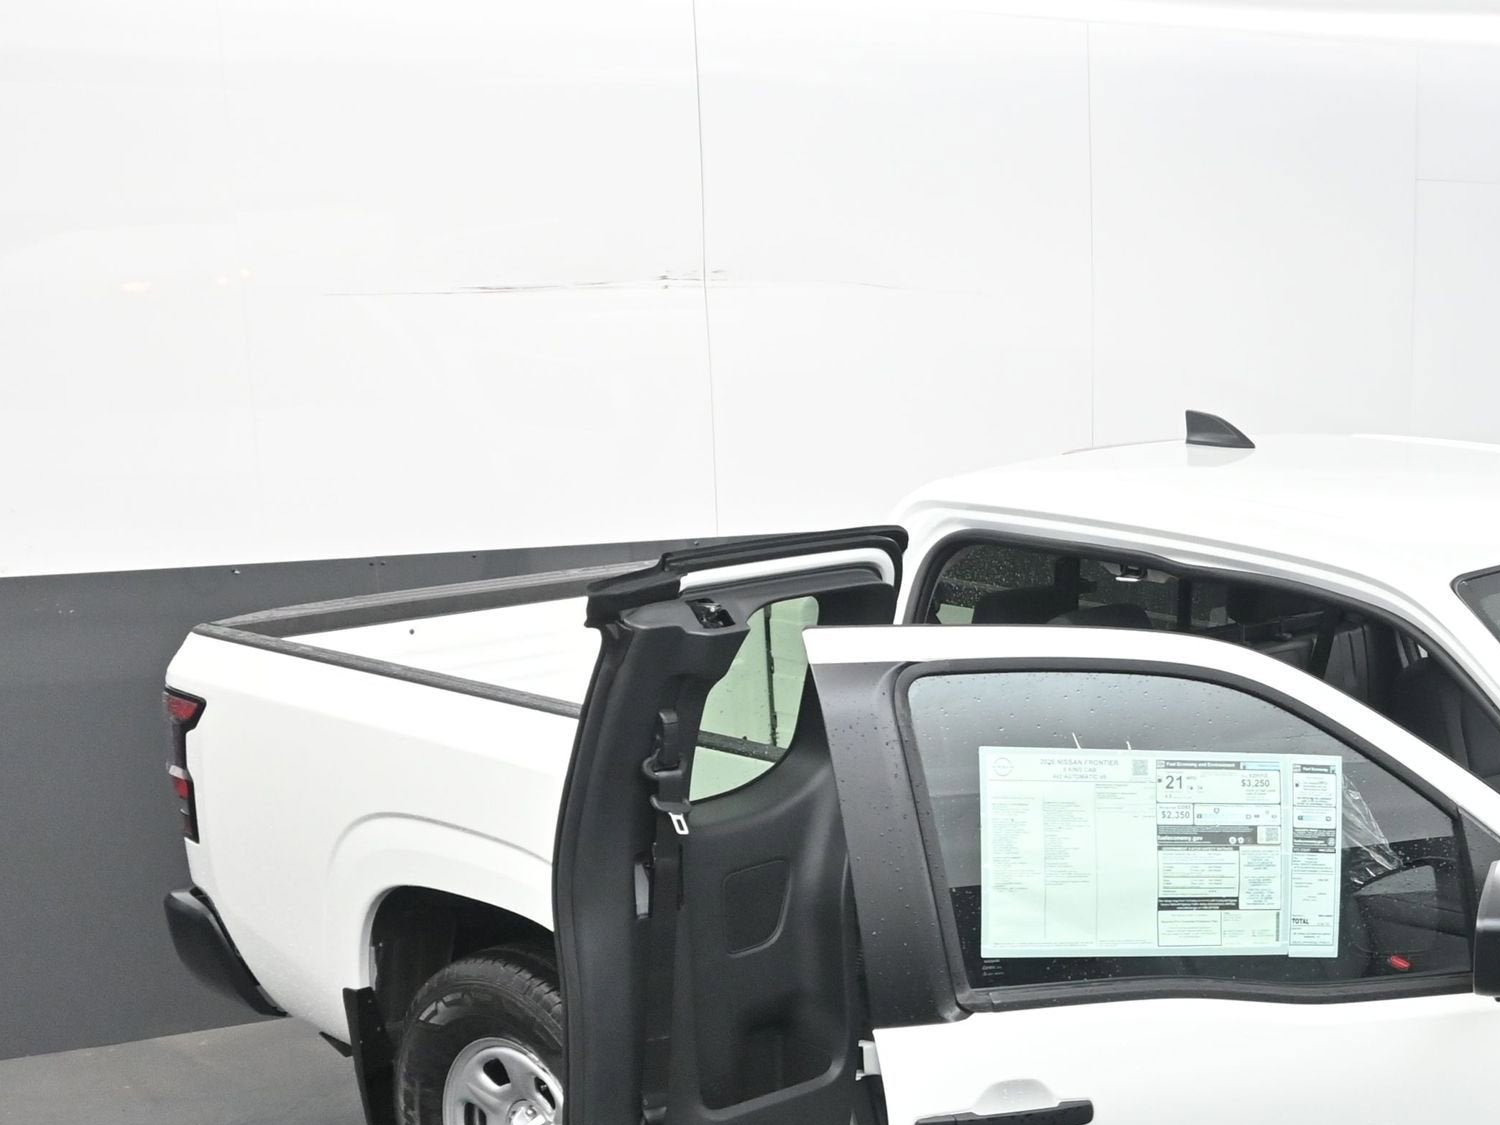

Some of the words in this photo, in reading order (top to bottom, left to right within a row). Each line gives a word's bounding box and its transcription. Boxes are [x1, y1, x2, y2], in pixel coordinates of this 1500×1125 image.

[1165, 775, 1183, 790] 21
[1241, 779, 1271, 789] $3,250
[1161, 811, 1191, 820] $2,350
[1292, 917, 1310, 926] TOTAL
